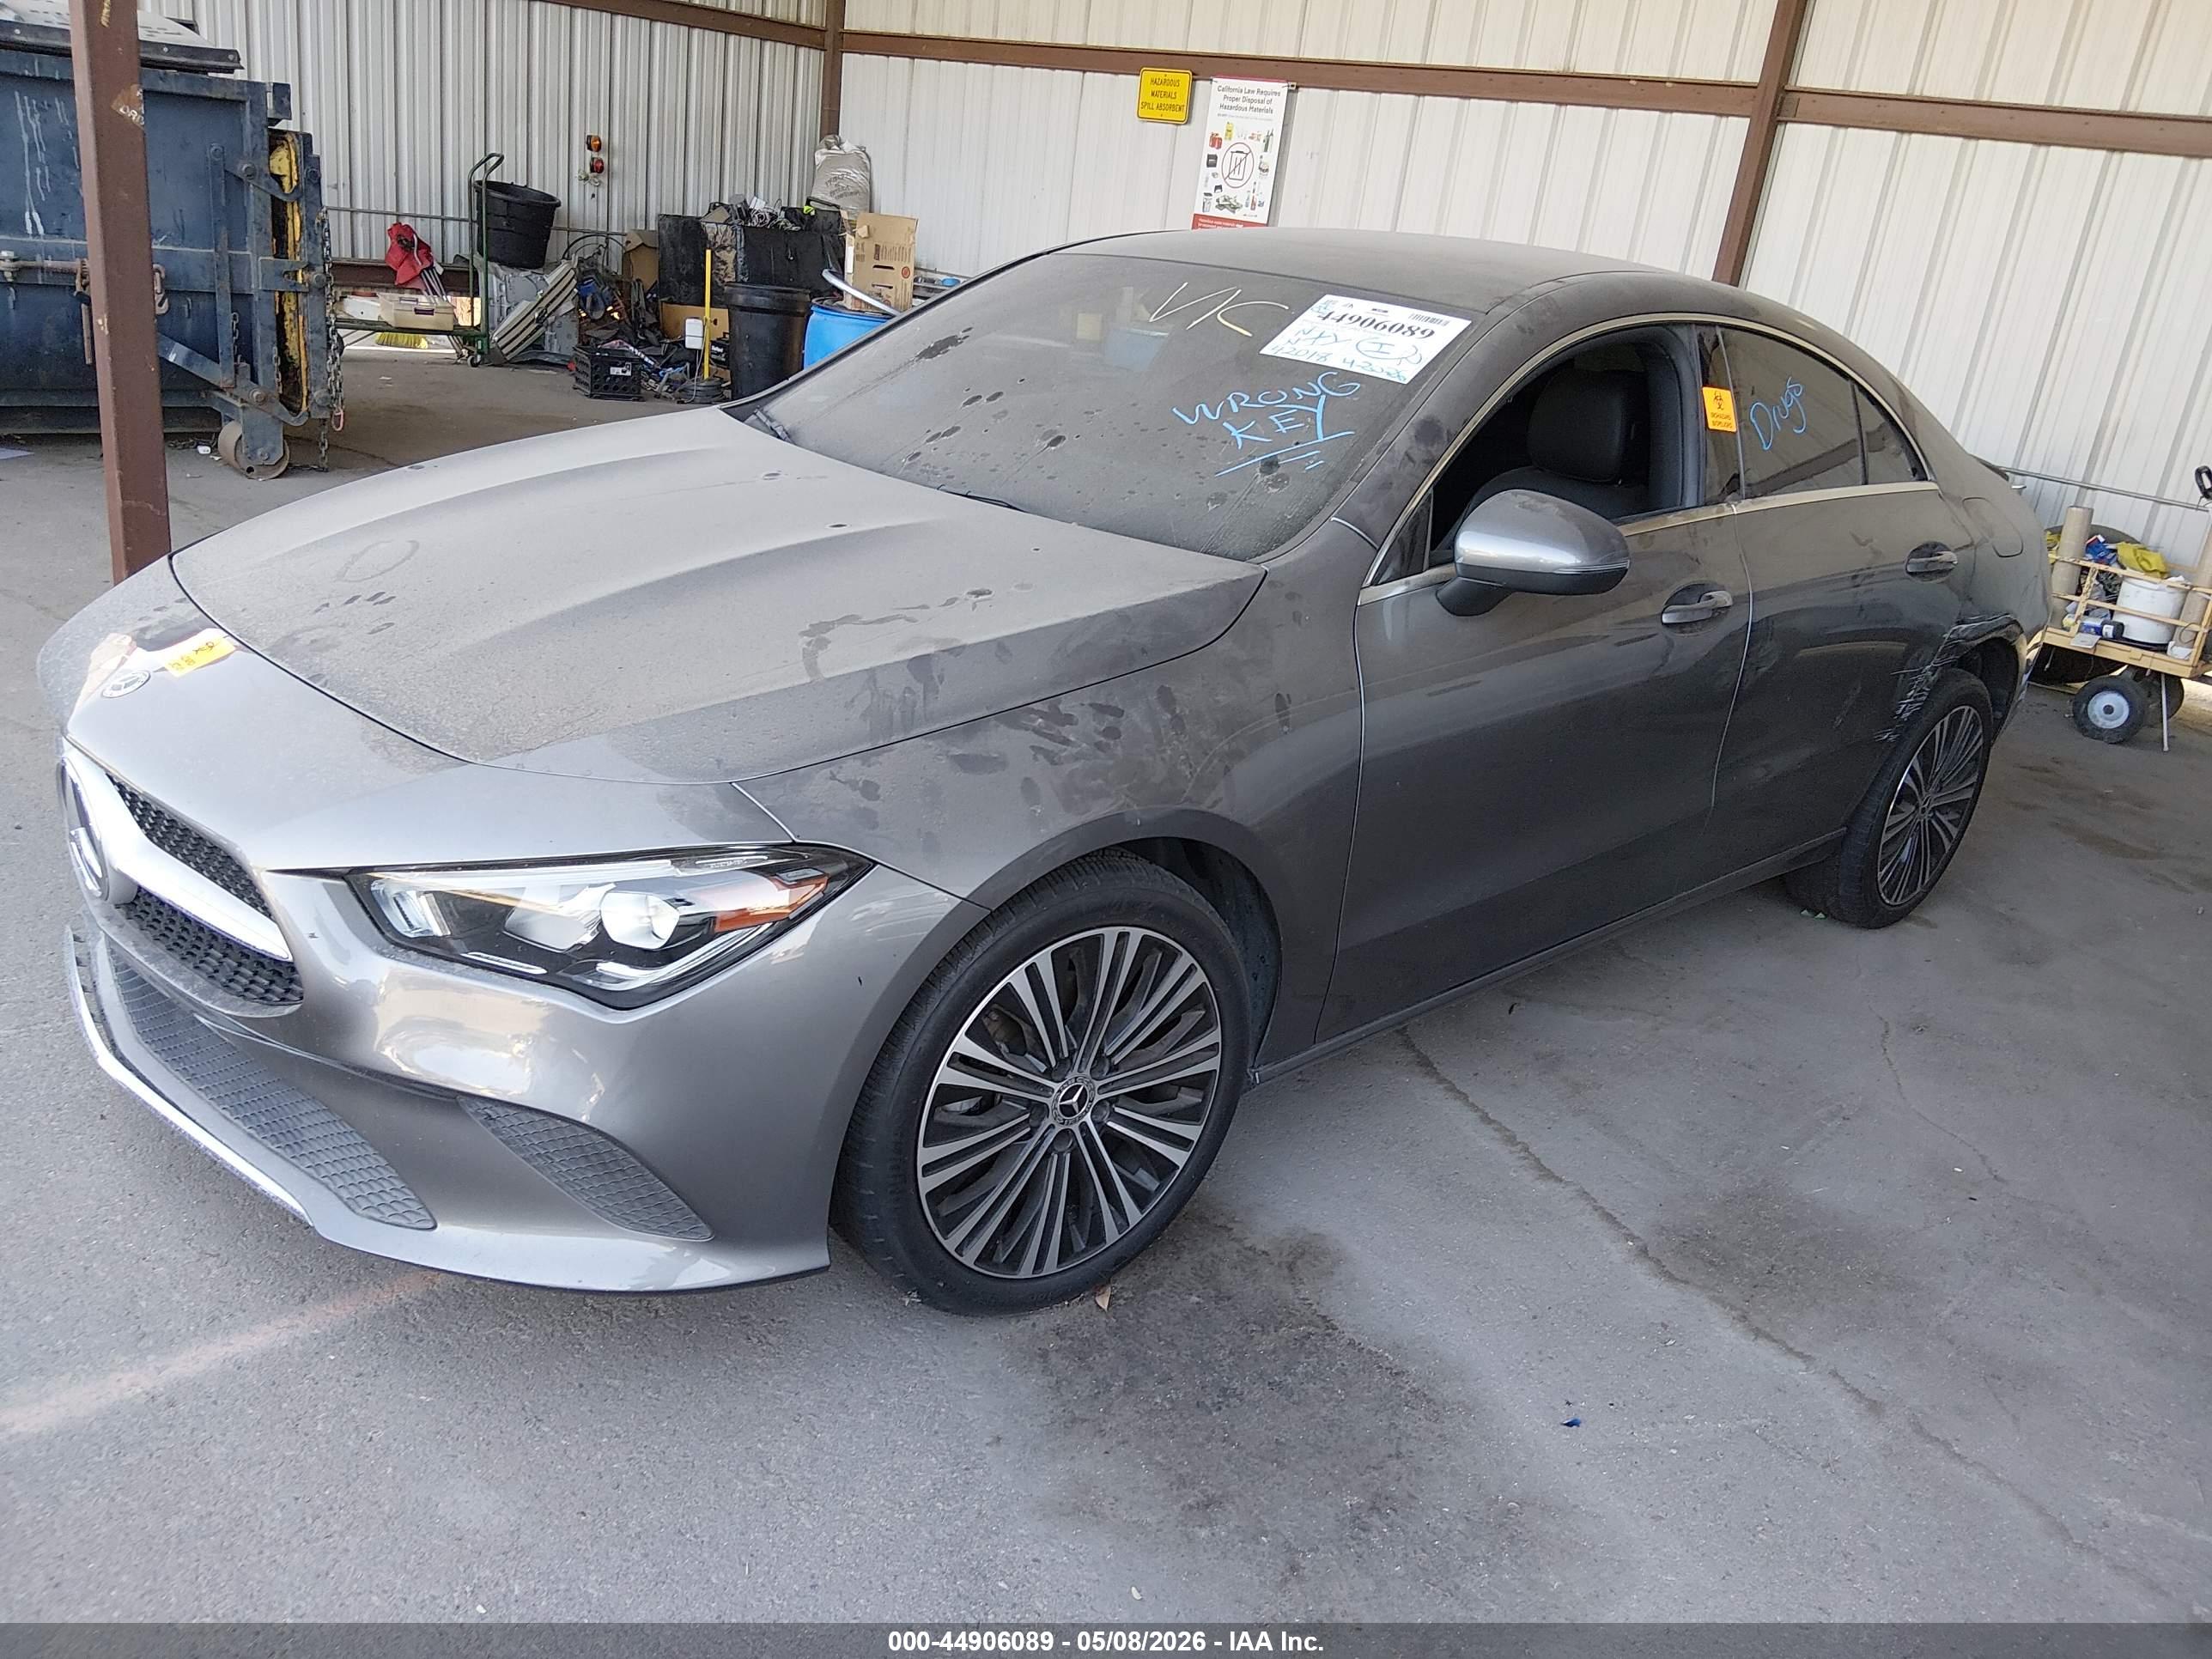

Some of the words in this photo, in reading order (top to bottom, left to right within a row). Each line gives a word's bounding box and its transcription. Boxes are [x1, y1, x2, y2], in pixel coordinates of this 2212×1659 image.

[1150, 77, 1181, 88] HAZARDOUS
[1151, 90, 1177, 100] MATERIALS
[1217, 85, 1243, 94] California
[1256, 88, 1281, 97] Requires
[1223, 94, 1241, 103] Proper
[1140, 101, 1155, 111] SPILL
[1155, 103, 1185, 112] ABSORBENT
[1219, 103, 1248, 112] Hazardous
[1249, 105, 1273, 114] Materials
[1317, 310, 1435, 339] 44906089
[1171, 371, 1361, 425] WRONG
[1222, 394, 1327, 449] KEY
